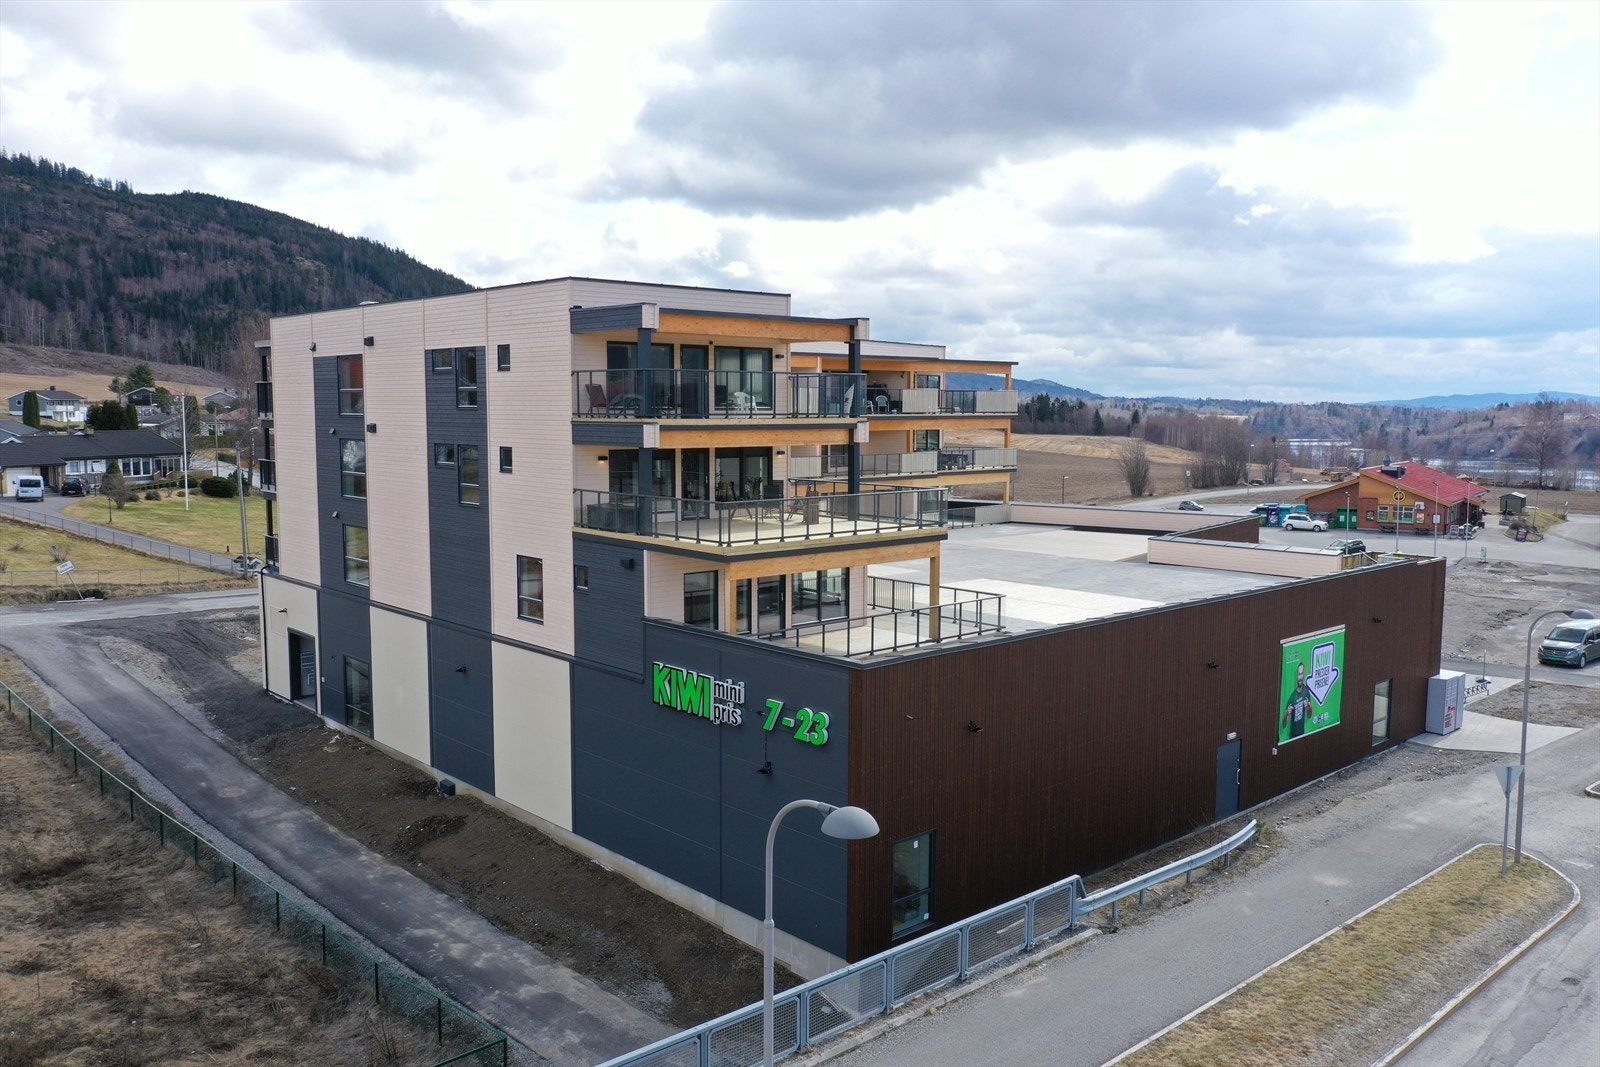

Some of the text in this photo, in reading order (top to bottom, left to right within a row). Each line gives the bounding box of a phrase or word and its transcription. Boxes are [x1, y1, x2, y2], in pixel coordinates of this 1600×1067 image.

[1315, 650, 1331, 668] KIWI
[652, 662, 714, 720] KIWI
[714, 678, 745, 704] mini
[713, 702, 742, 726] pris
